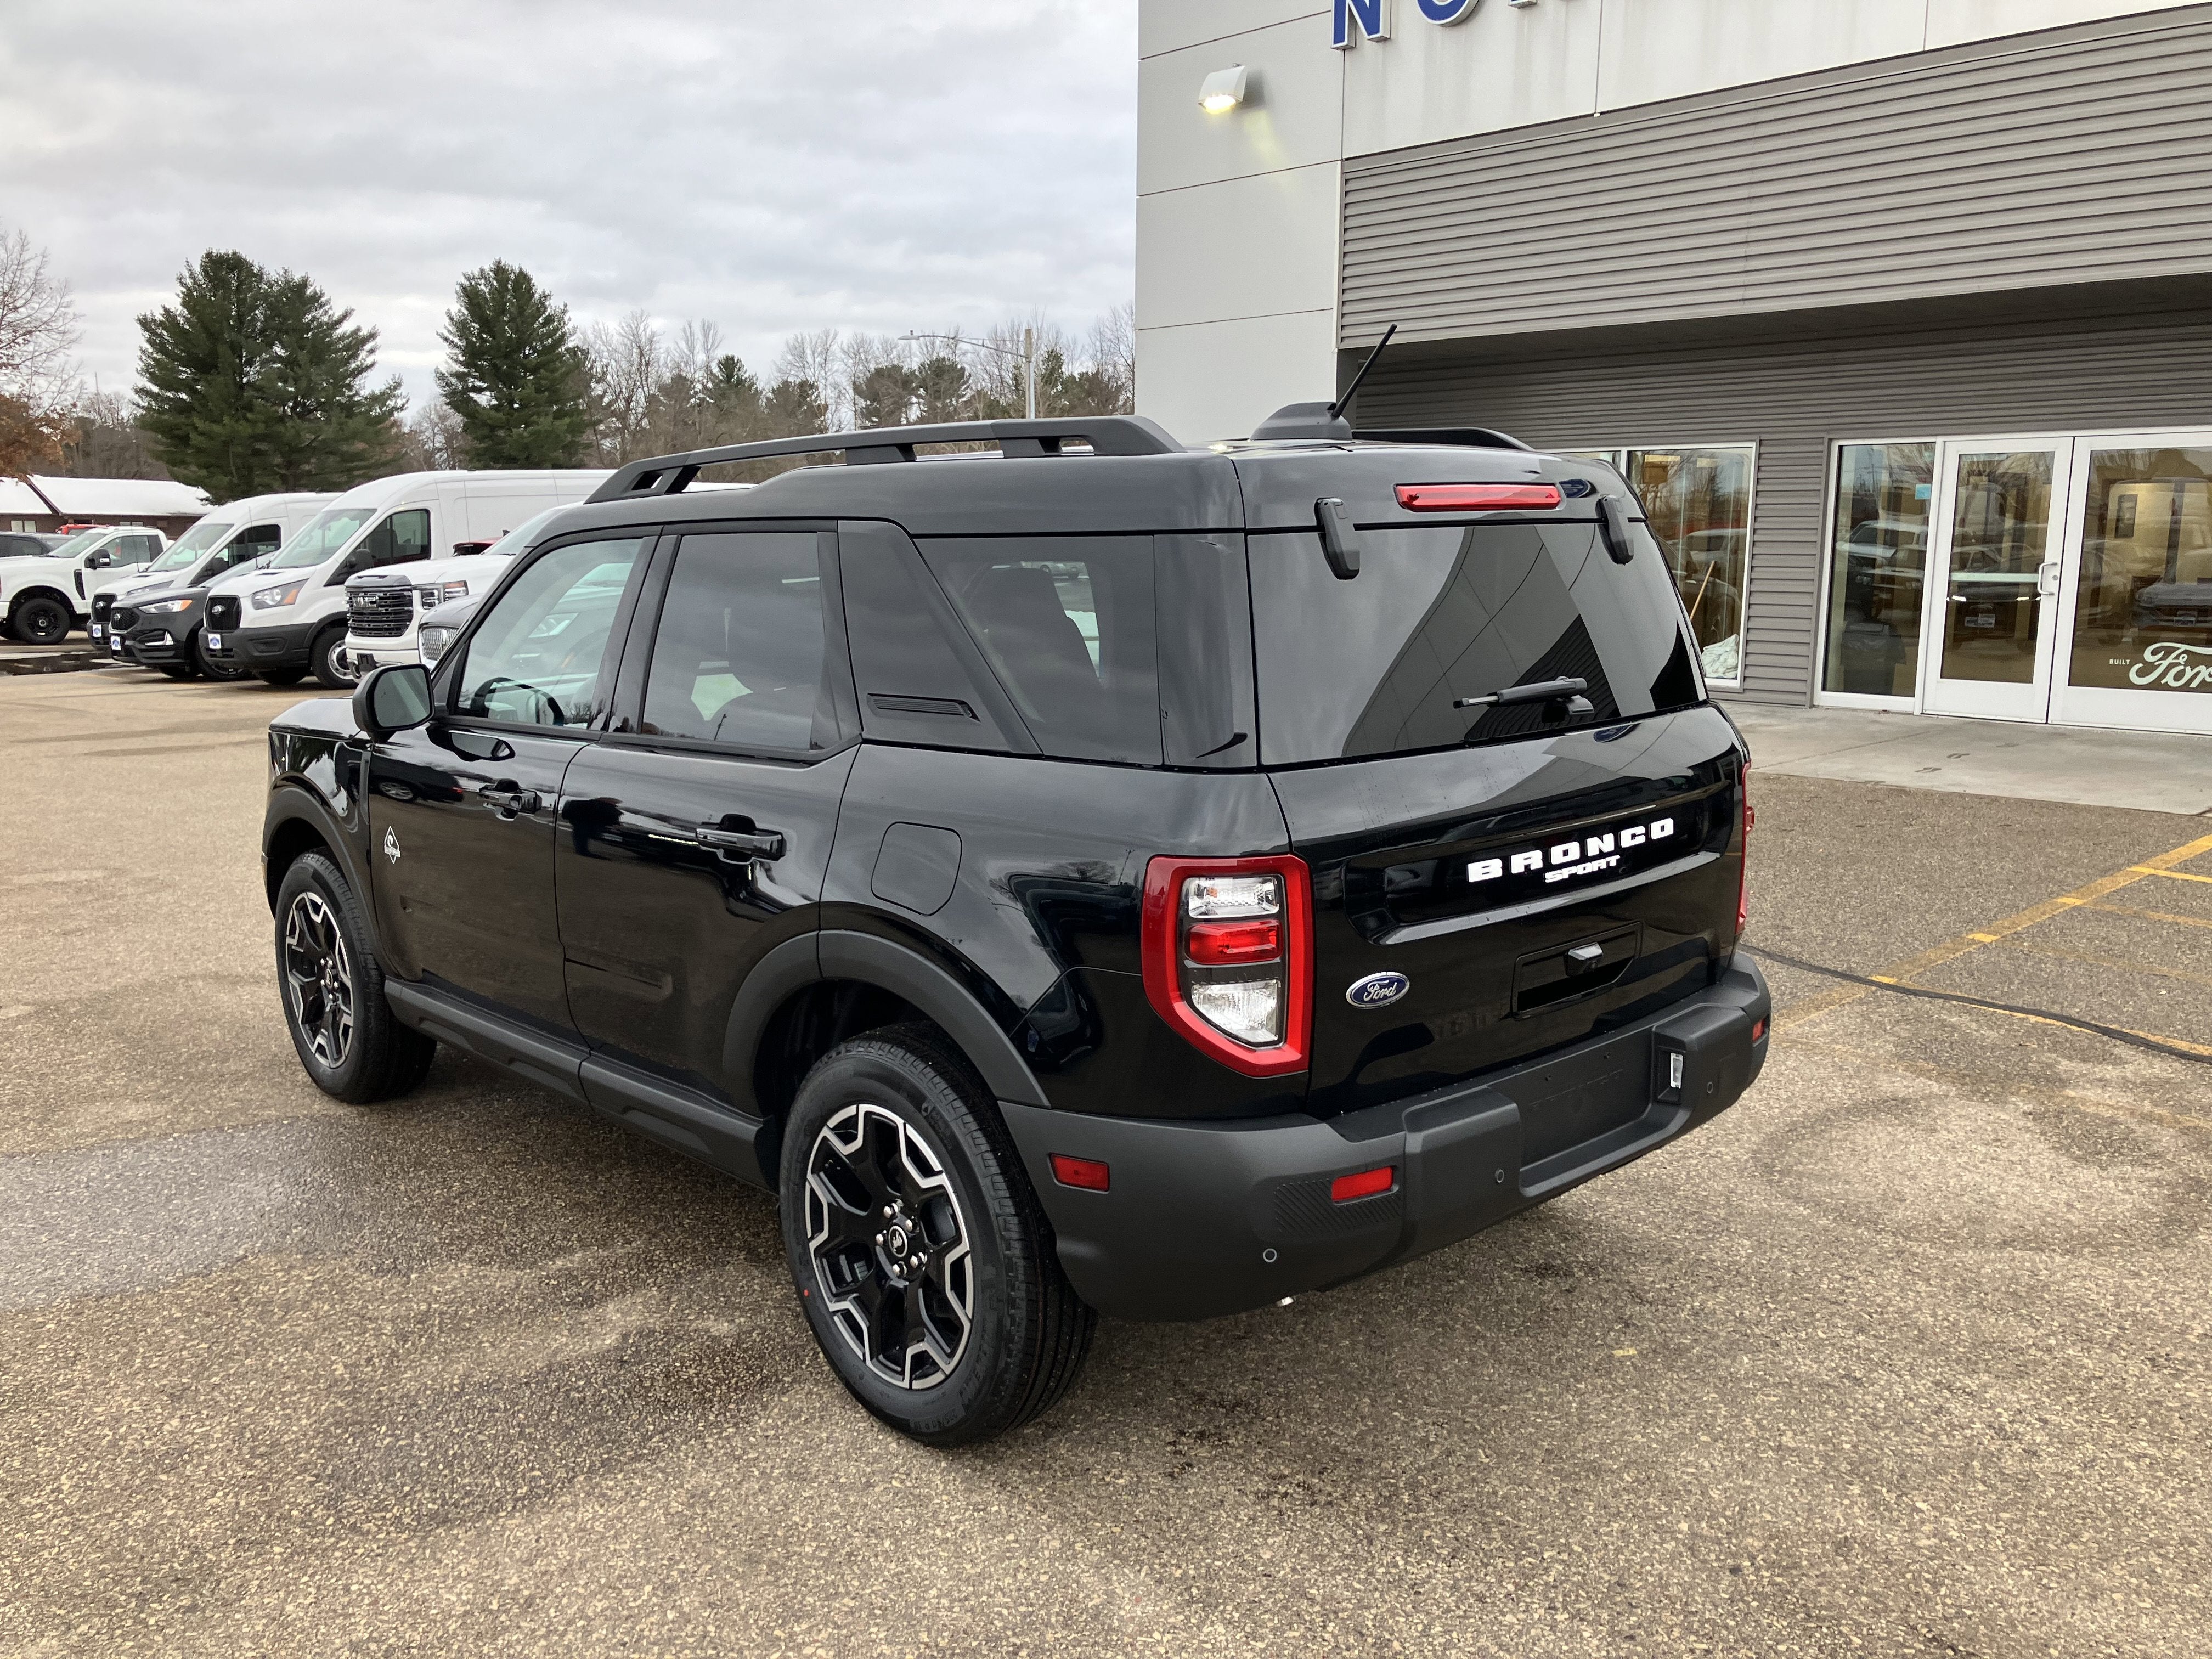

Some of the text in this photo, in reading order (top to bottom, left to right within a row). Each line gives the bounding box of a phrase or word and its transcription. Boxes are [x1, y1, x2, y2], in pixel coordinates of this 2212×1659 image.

[2129, 642, 2212, 688] For
[1466, 817, 1674, 883] BRONCO
[1544, 854, 1621, 883] SPORT
[1363, 979, 1397, 1002] Ford
